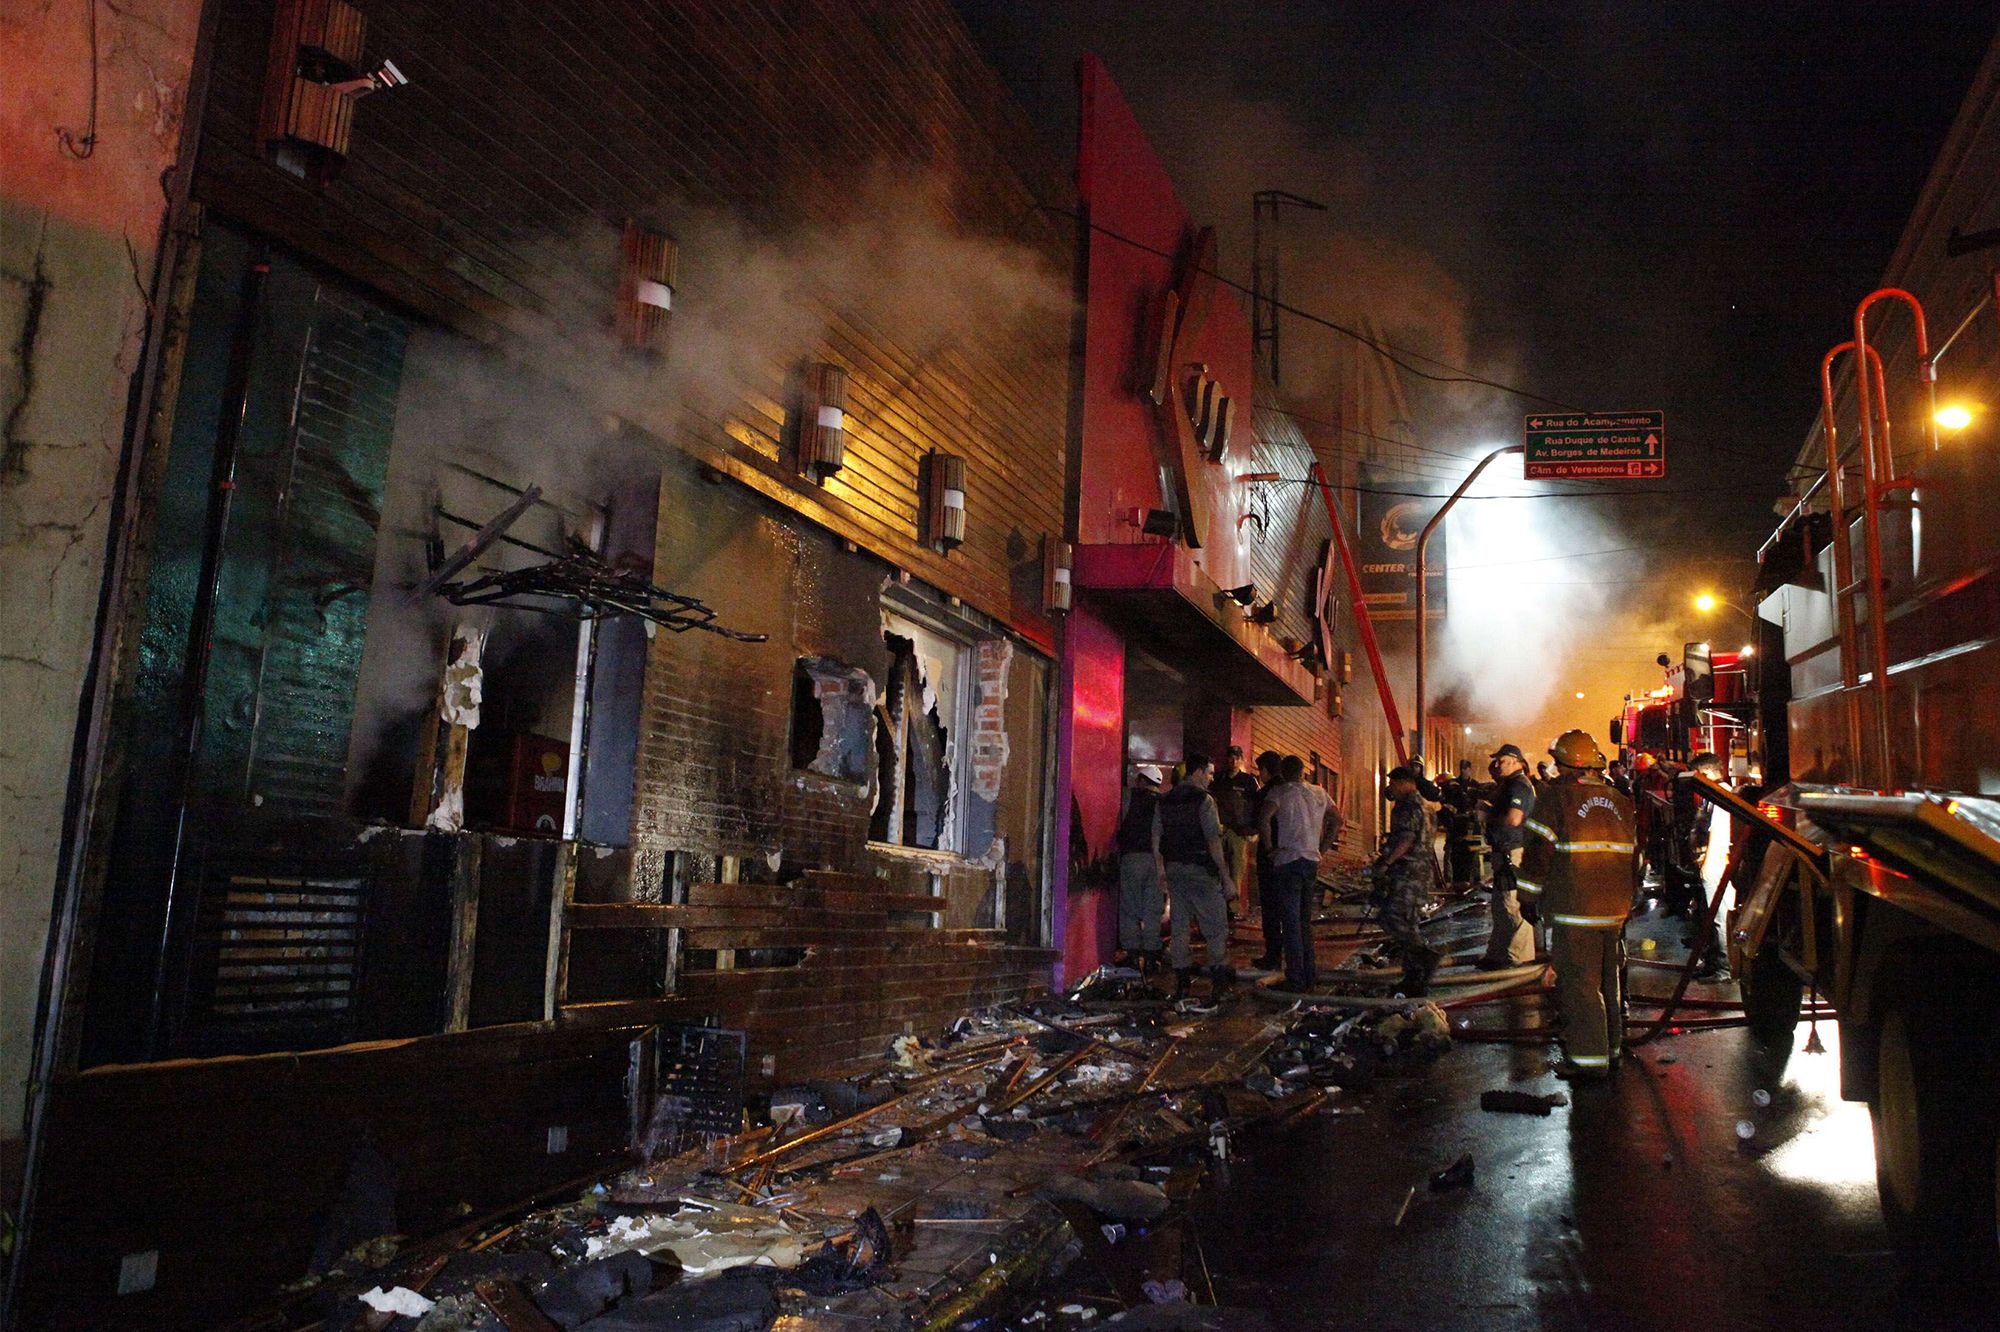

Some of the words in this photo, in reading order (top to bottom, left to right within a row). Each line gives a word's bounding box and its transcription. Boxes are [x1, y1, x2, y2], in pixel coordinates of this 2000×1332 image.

[1546, 419, 1564, 427] Rua
[1566, 417, 1579, 426] do
[1583, 417, 1651, 428] Acampmento
[1544, 437, 1563, 445] Rua
[1564, 436, 1594, 446] Duque
[1597, 435, 1609, 444] de
[1611, 435, 1641, 444] Caxias
[1535, 449, 1549, 457] Av.
[1551, 448, 1583, 458] Borges
[1587, 447, 1598, 456] de
[1600, 447, 1642, 456] Medeiros
[1556, 465, 1568, 474] de
[1571, 465, 1625, 474] Vereadores
[1362, 563, 1405, 573] CENTER
